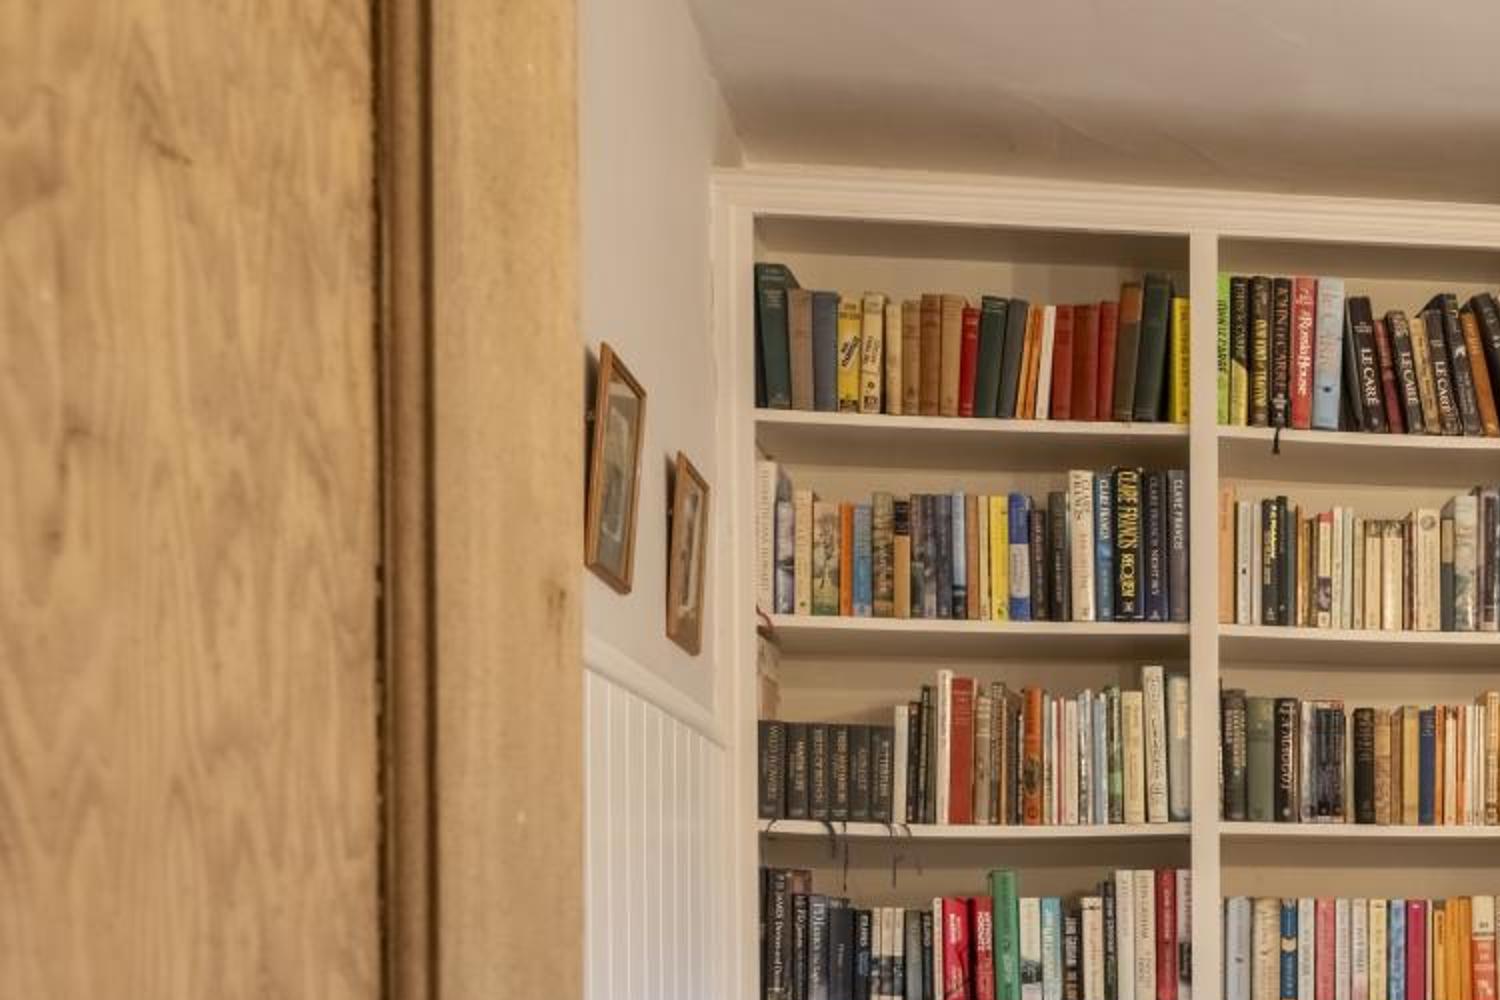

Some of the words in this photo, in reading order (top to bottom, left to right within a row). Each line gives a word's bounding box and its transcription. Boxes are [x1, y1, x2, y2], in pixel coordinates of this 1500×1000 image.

[1361, 348, 1374, 366] LE
[1117, 471, 1138, 503] CLARE
[1117, 506, 1138, 549] FRANCIS
